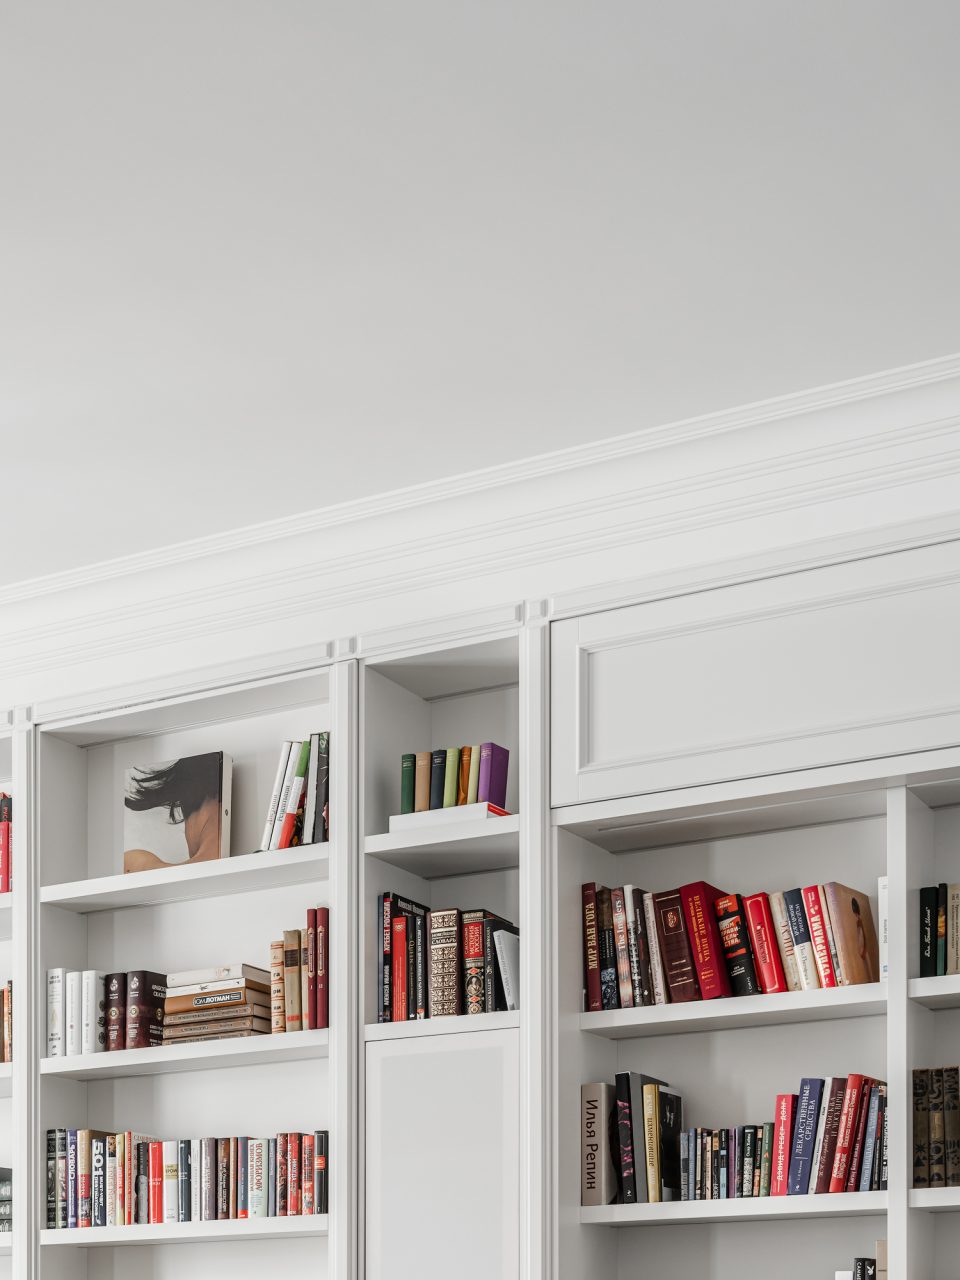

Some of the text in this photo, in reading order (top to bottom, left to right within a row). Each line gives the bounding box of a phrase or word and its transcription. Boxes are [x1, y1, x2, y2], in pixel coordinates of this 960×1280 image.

[431, 938, 457, 946] СЛОВАРЬ
[585, 903, 598, 970] МИР ВАН ГОГА
[614, 900, 627, 951] The Insiders
[693, 895, 711, 962] ВЕЛИКИЕ ВИНА
[810, 915, 832, 977] СУПЕРМАМА
[585, 1099, 599, 1191] Илья Репин
[795, 1084, 811, 1155] ЛЕКАРСТВЕННЫЕ
[805, 1099, 816, 1141] СРЕДСТВА
[93, 1141, 105, 1176] 501
[254, 1143, 263, 1192] АФОРИЗМОВ
